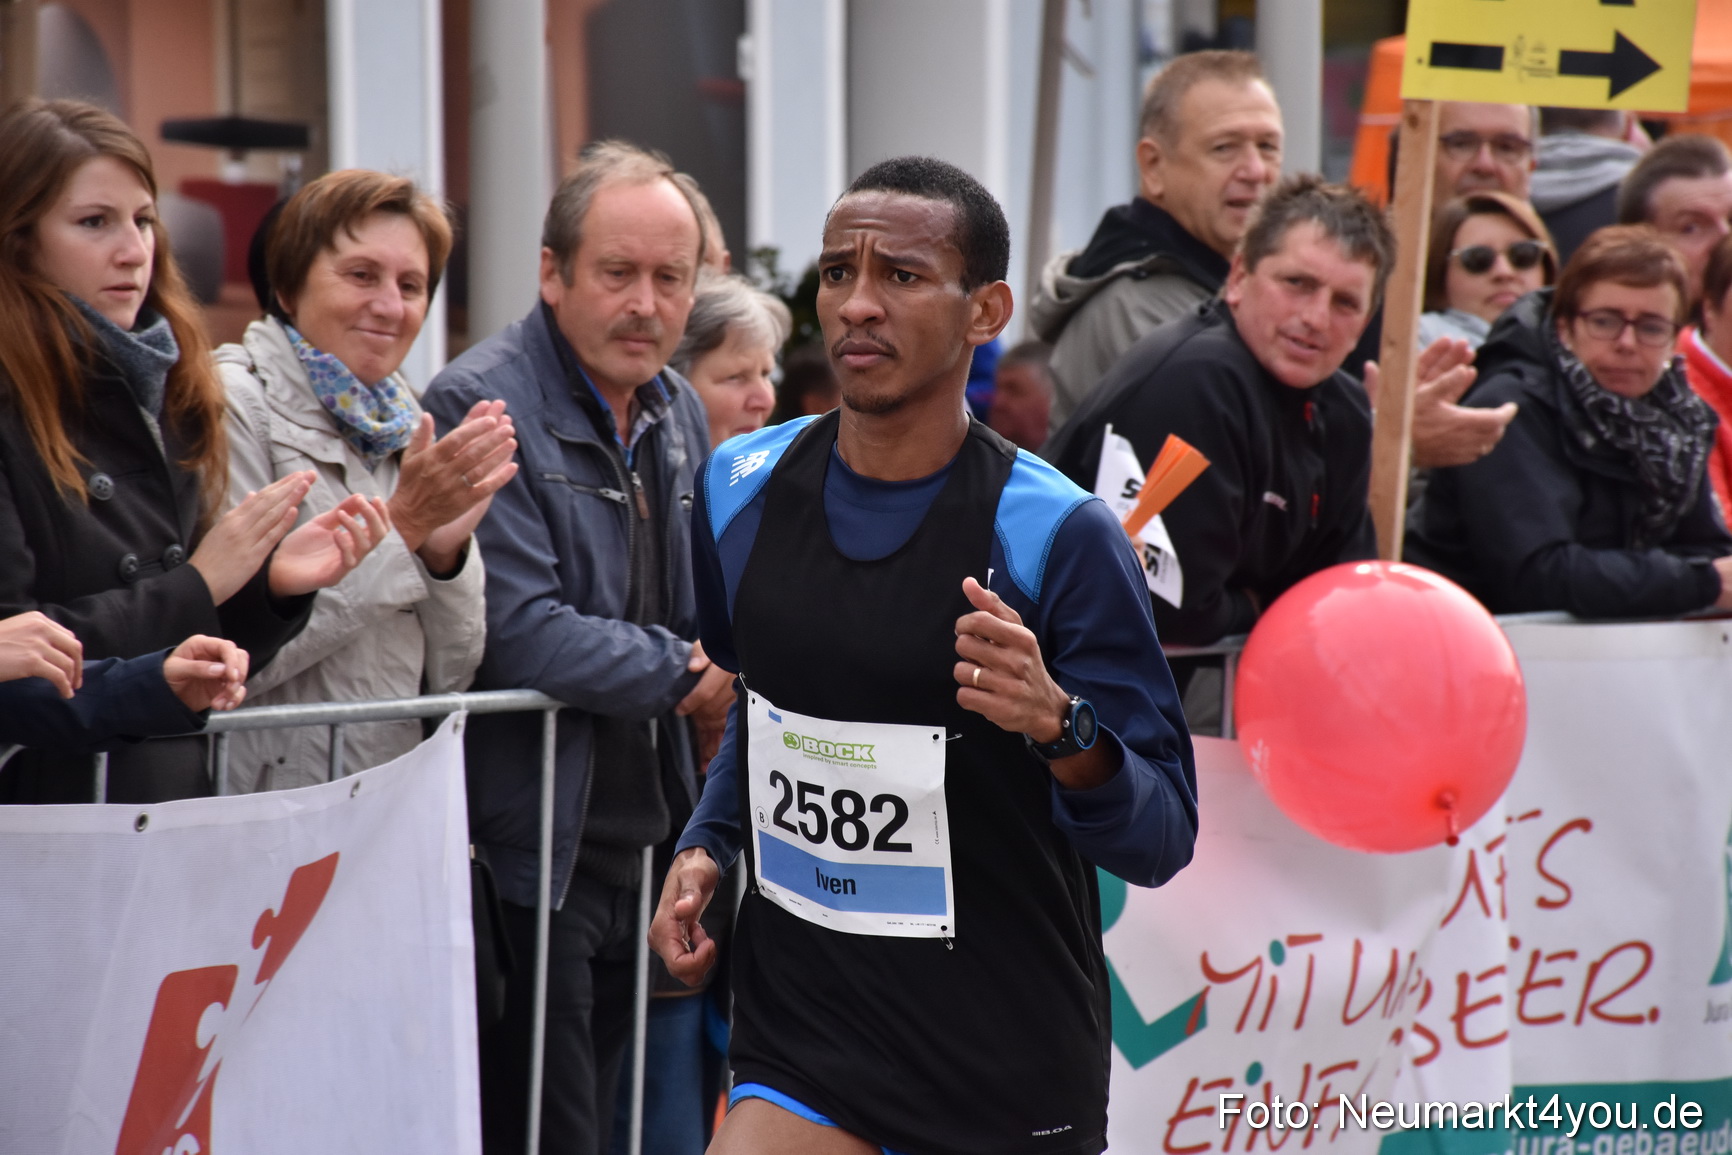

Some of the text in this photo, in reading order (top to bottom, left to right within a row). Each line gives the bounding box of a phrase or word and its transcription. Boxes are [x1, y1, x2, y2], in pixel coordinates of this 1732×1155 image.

[801, 735, 876, 762] BOCK
[803, 752, 824, 762] inspired
[849, 761, 877, 769] concepts
[770, 770, 912, 852] 2582
[816, 867, 857, 895] Iven
